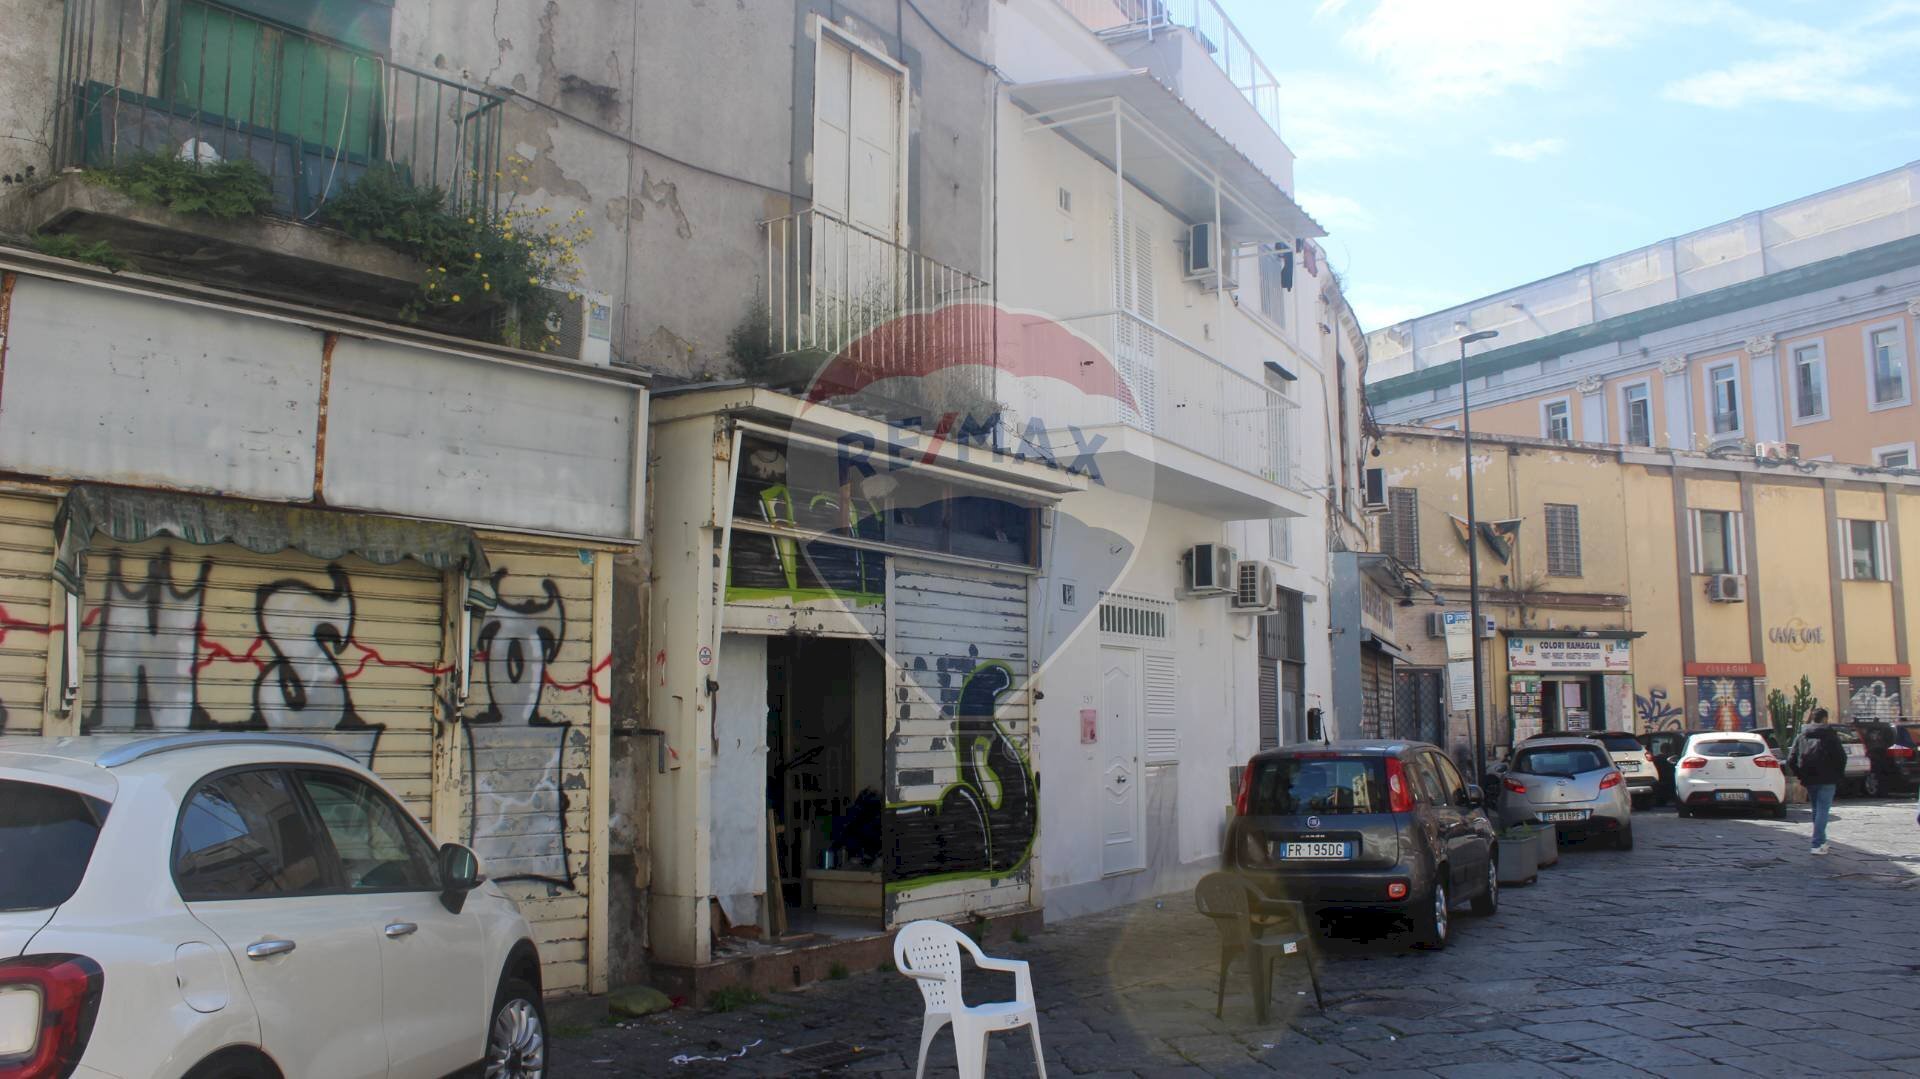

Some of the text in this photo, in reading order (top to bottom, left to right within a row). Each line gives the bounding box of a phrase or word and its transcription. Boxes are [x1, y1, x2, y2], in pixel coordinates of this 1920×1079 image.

[1769, 626, 1797, 644] CASA
[1540, 641, 1601, 650] COLORI RAMAGLIA
[1288, 843, 1343, 857] FR 195DG
